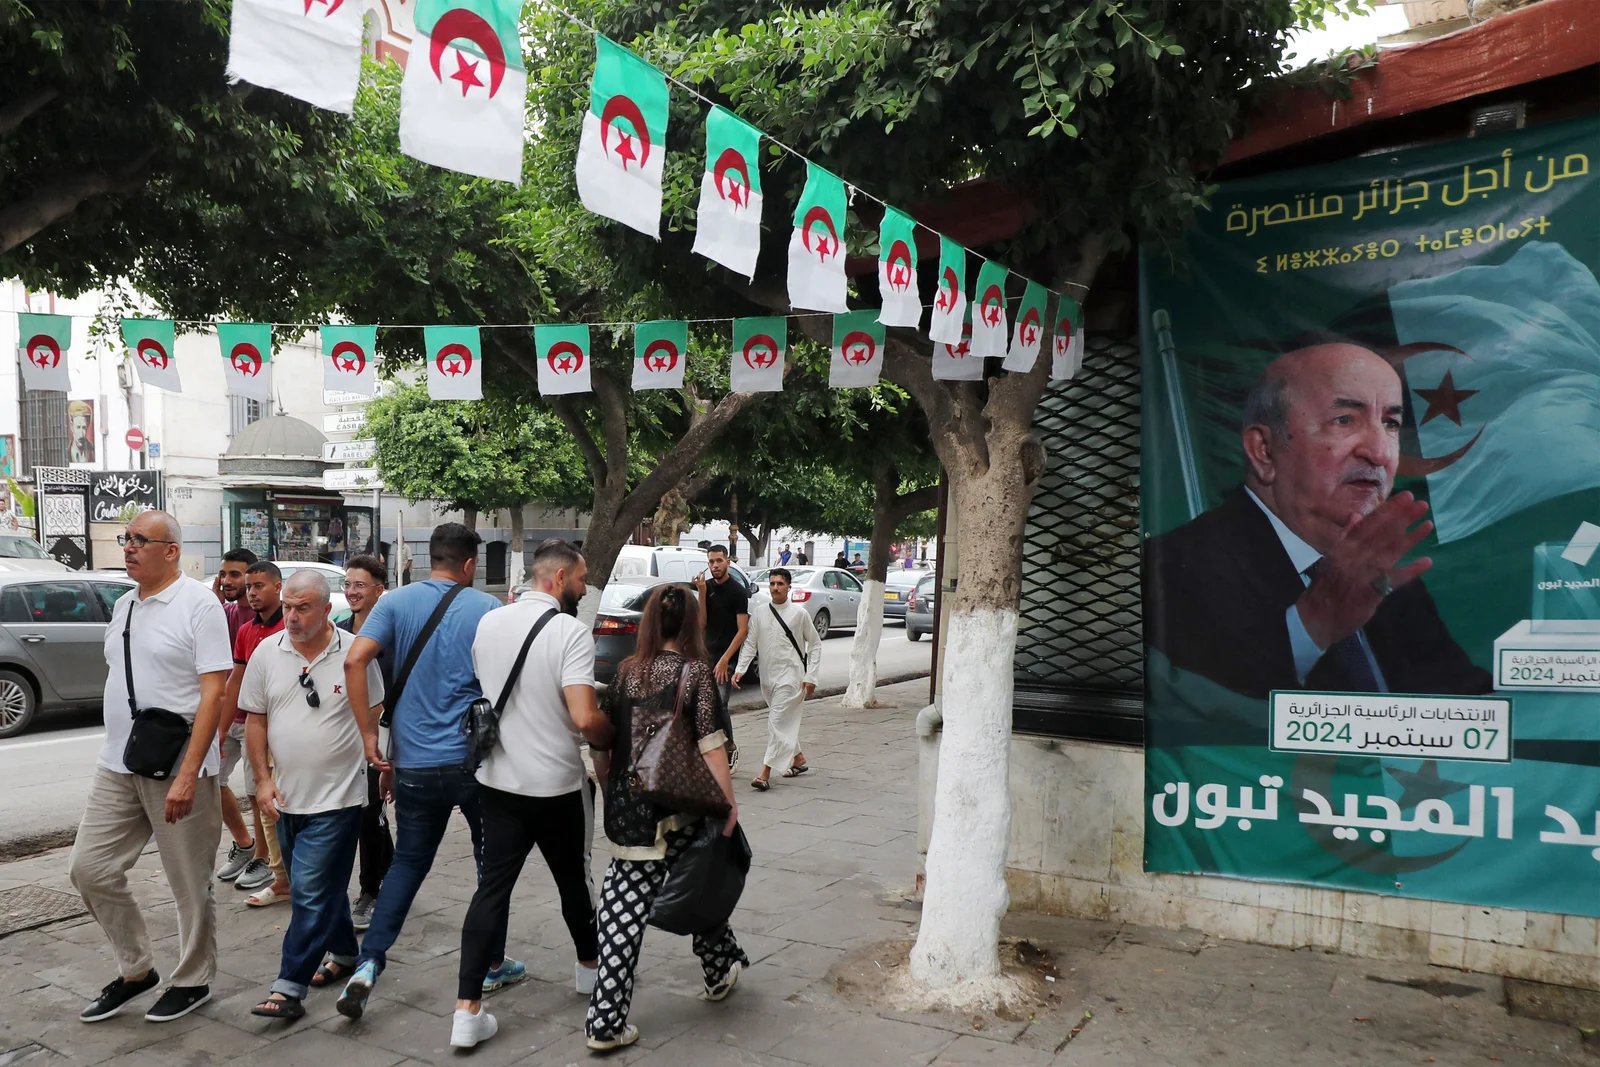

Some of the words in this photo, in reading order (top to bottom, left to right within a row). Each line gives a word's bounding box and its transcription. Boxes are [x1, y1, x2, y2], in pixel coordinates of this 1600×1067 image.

[1441, 148, 1513, 206] أجل
[1525, 153, 1588, 193] من
[1352, 177, 1429, 221] جزائر
[1226, 193, 1344, 237] منتصرة
[1511, 656, 1554, 666] الجزائرية
[1556, 656, 1597, 666] الرئاسية
[1510, 667, 1554, 681] 2024
[334, 685, 342, 694] K
[1289, 702, 1351, 719] الجزائرية
[1354, 704, 1417, 721] الرئاسية
[1286, 720, 1352, 743] 2024
[1357, 727, 1453, 751] سبتمبر
[1463, 728, 1499, 750] 07
[1152, 774, 1283, 831] تبون
[1299, 785, 1513, 843] المجيد
